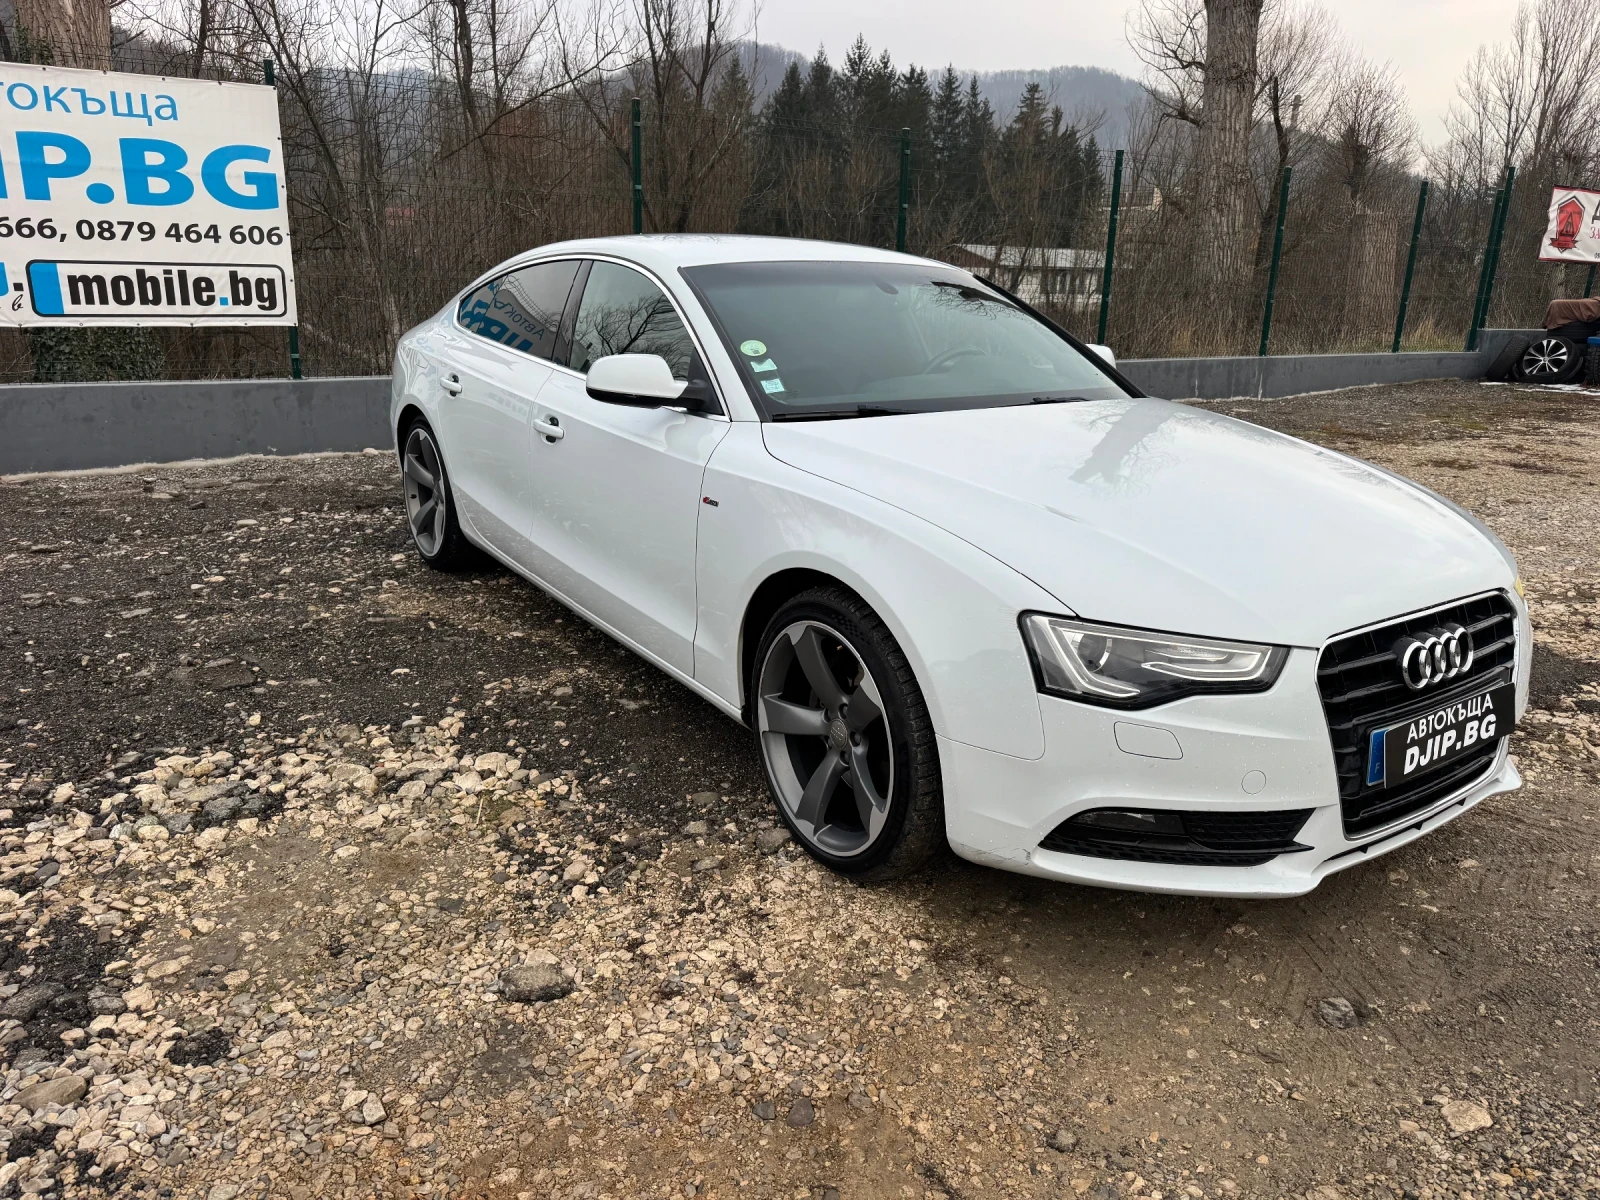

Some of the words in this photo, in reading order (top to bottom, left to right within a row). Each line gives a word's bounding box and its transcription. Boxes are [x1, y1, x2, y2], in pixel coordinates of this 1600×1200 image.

[0, 81, 179, 127] окъща
[75, 219, 156, 241] 0879
[164, 223, 222, 244] 464
[229, 225, 284, 246] 606
[67, 268, 278, 311] mobile.bg
[1407, 693, 1494, 744] АВТОКЪЩА
[1404, 714, 1497, 775] DJIP.BG
